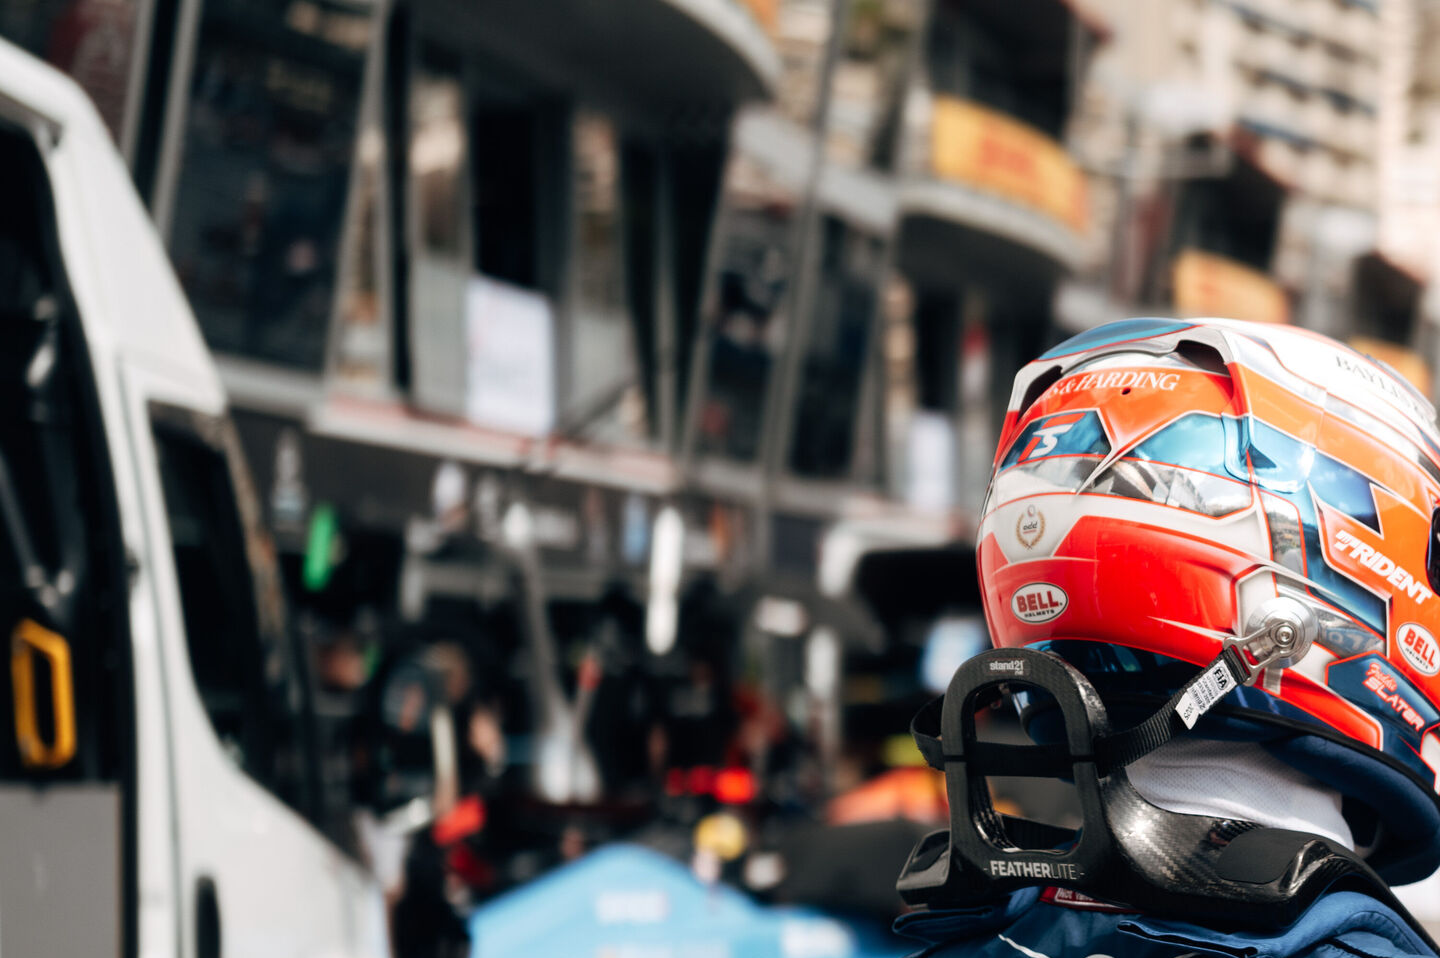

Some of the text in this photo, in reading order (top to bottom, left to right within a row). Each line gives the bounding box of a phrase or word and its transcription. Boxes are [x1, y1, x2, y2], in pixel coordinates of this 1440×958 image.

[1073, 371, 1181, 392] HARDING
[1334, 529, 1433, 604] TRIDENT
[1016, 590, 1060, 613] BELL
[1404, 628, 1436, 668] BELL
[1213, 668, 1228, 689] FIA
[1362, 676, 1426, 732] SLATER
[990, 860, 1078, 880] FEATHERLITE
